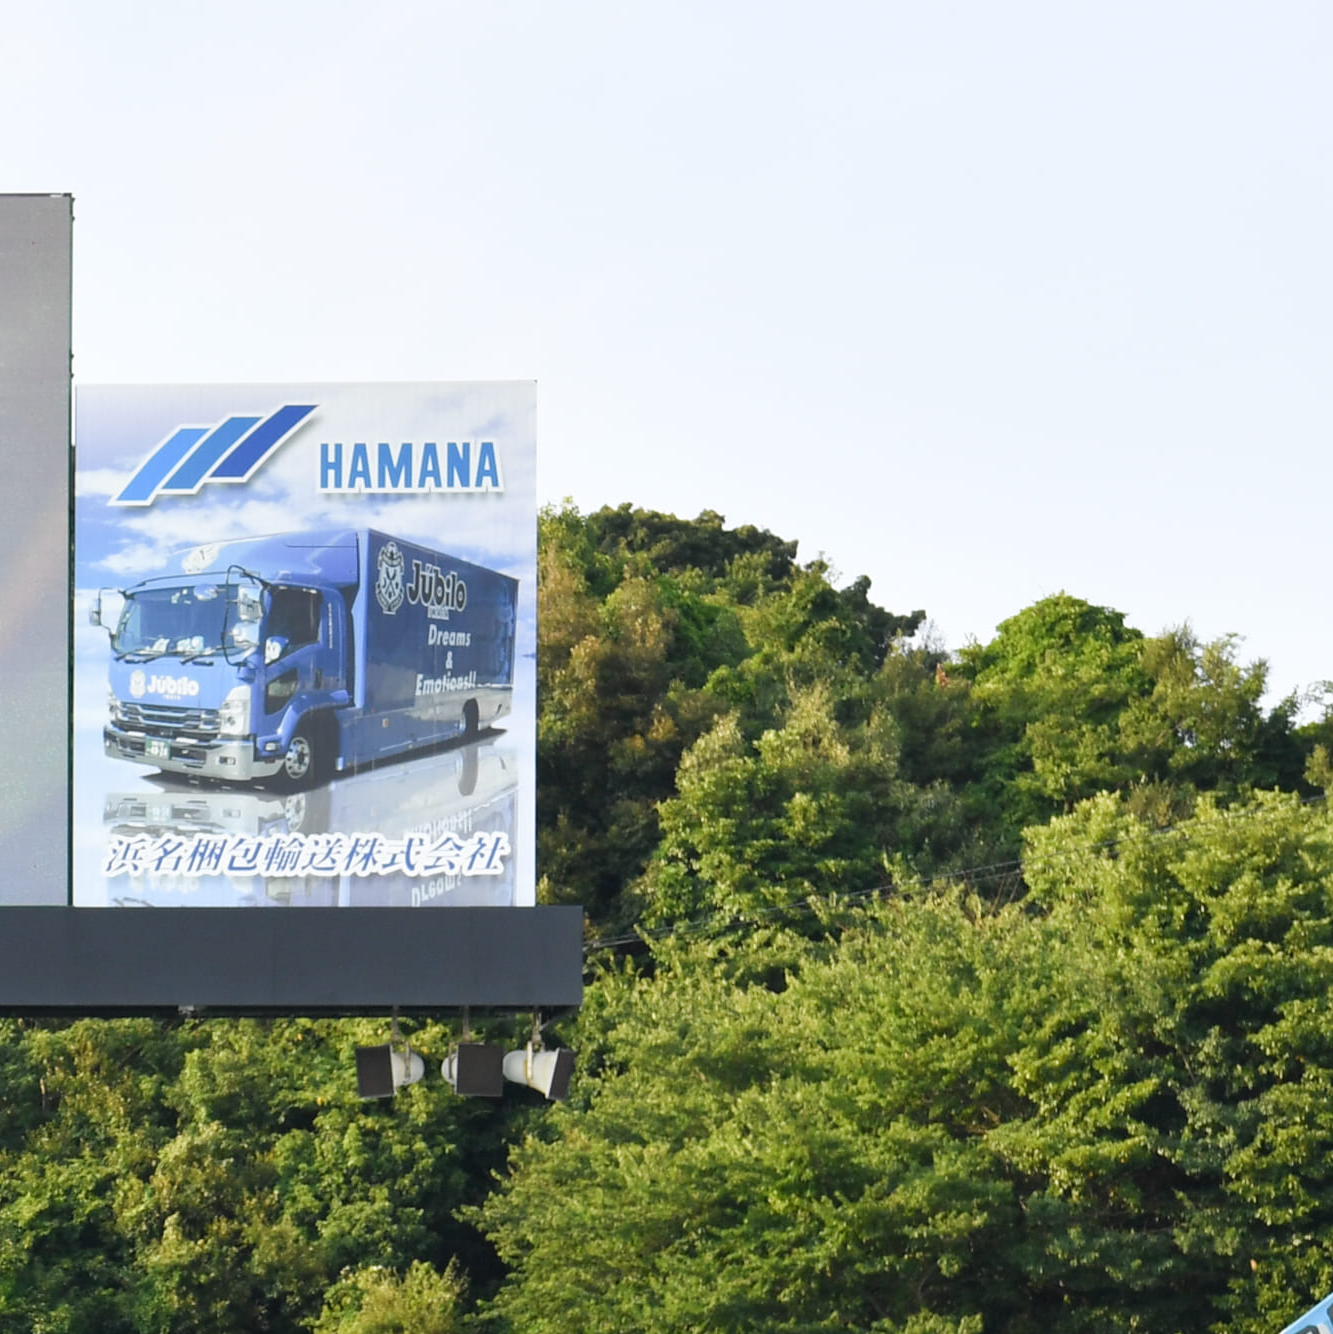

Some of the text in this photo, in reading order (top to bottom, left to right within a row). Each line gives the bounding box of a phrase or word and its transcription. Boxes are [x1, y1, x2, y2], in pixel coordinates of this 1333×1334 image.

[319, 442, 500, 490] HAMANA
[428, 624, 471, 646] Dreams
[445, 651, 453, 669] &
[106, 837, 507, 873] 浜名梱包輸送株式会社
